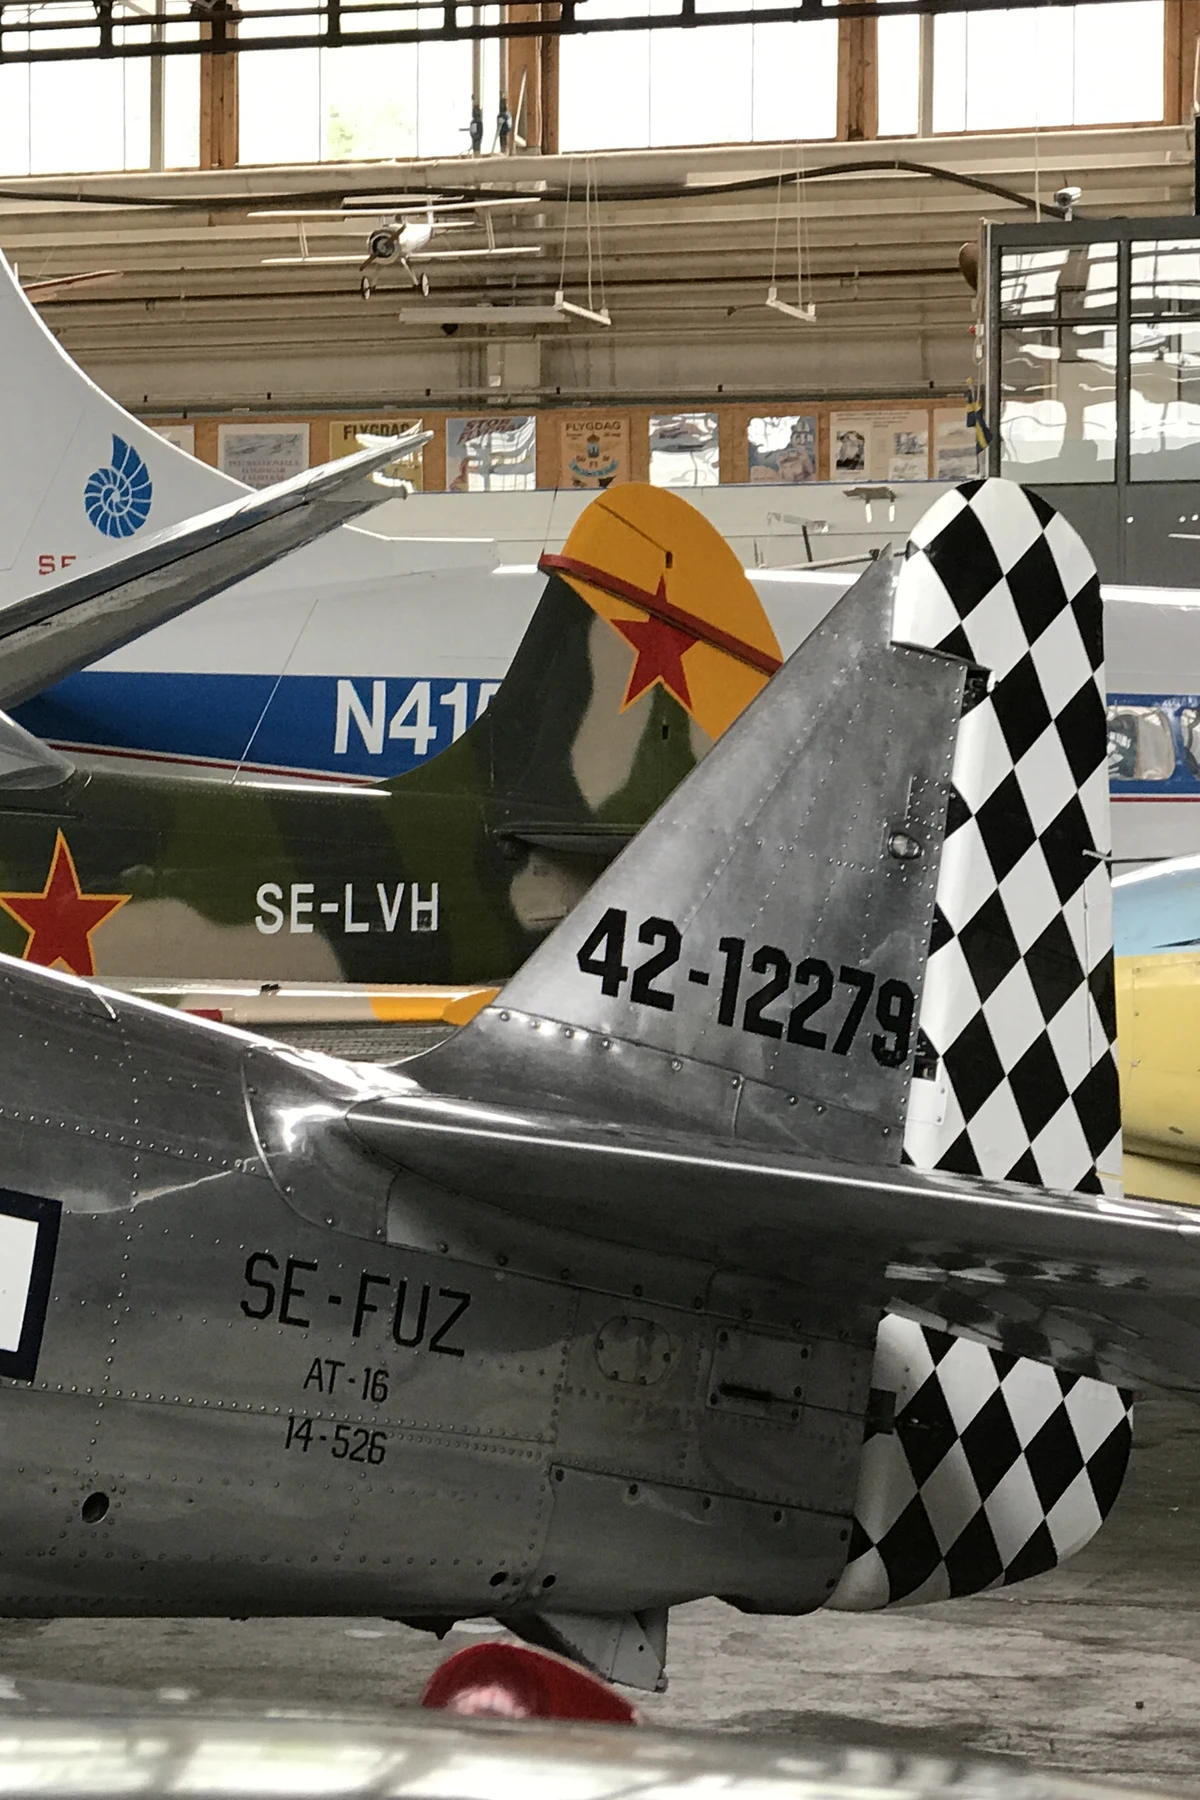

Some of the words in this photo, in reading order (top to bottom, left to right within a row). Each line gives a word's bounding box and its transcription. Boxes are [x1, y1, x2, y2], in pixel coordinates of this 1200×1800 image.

[566, 421, 621, 431] FLYGDAG
[255, 882, 440, 935] SE-LVH
[576, 907, 915, 1069] 42-12279
[303, 1357, 389, 1403] AT-16
[285, 1416, 387, 1465] 14-526
